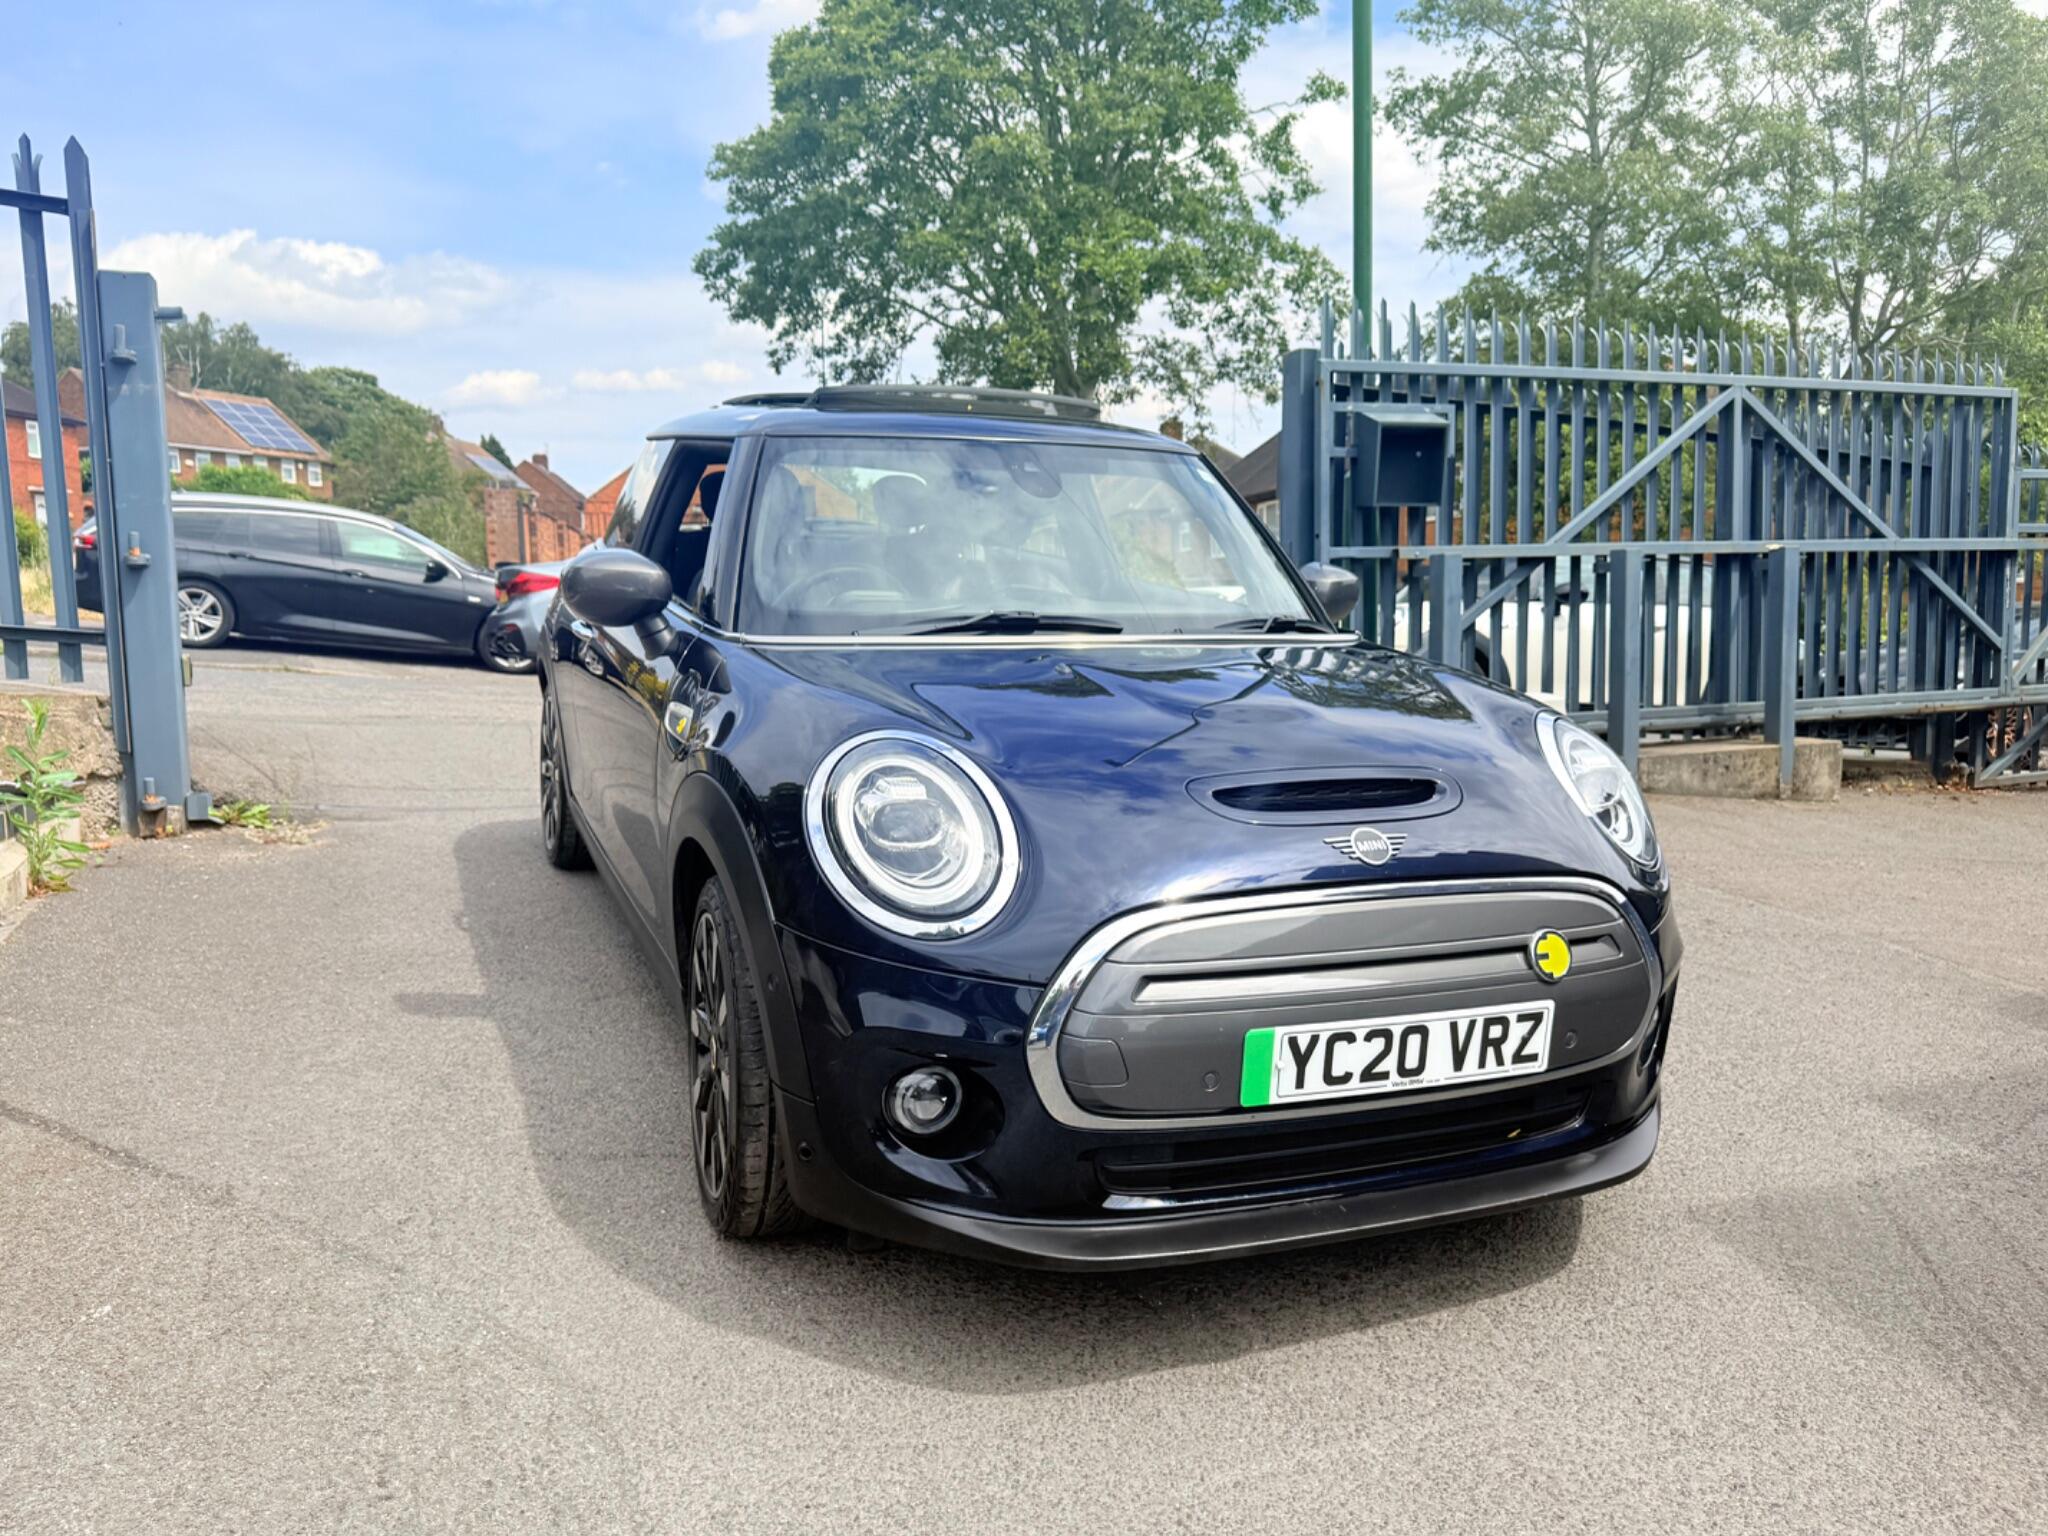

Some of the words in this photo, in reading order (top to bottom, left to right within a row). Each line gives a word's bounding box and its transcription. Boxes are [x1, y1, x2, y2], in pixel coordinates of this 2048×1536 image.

[1357, 840, 1387, 851] MINI
[1288, 1024, 1429, 1089] YC20
[1450, 1012, 1544, 1072] VRZ
